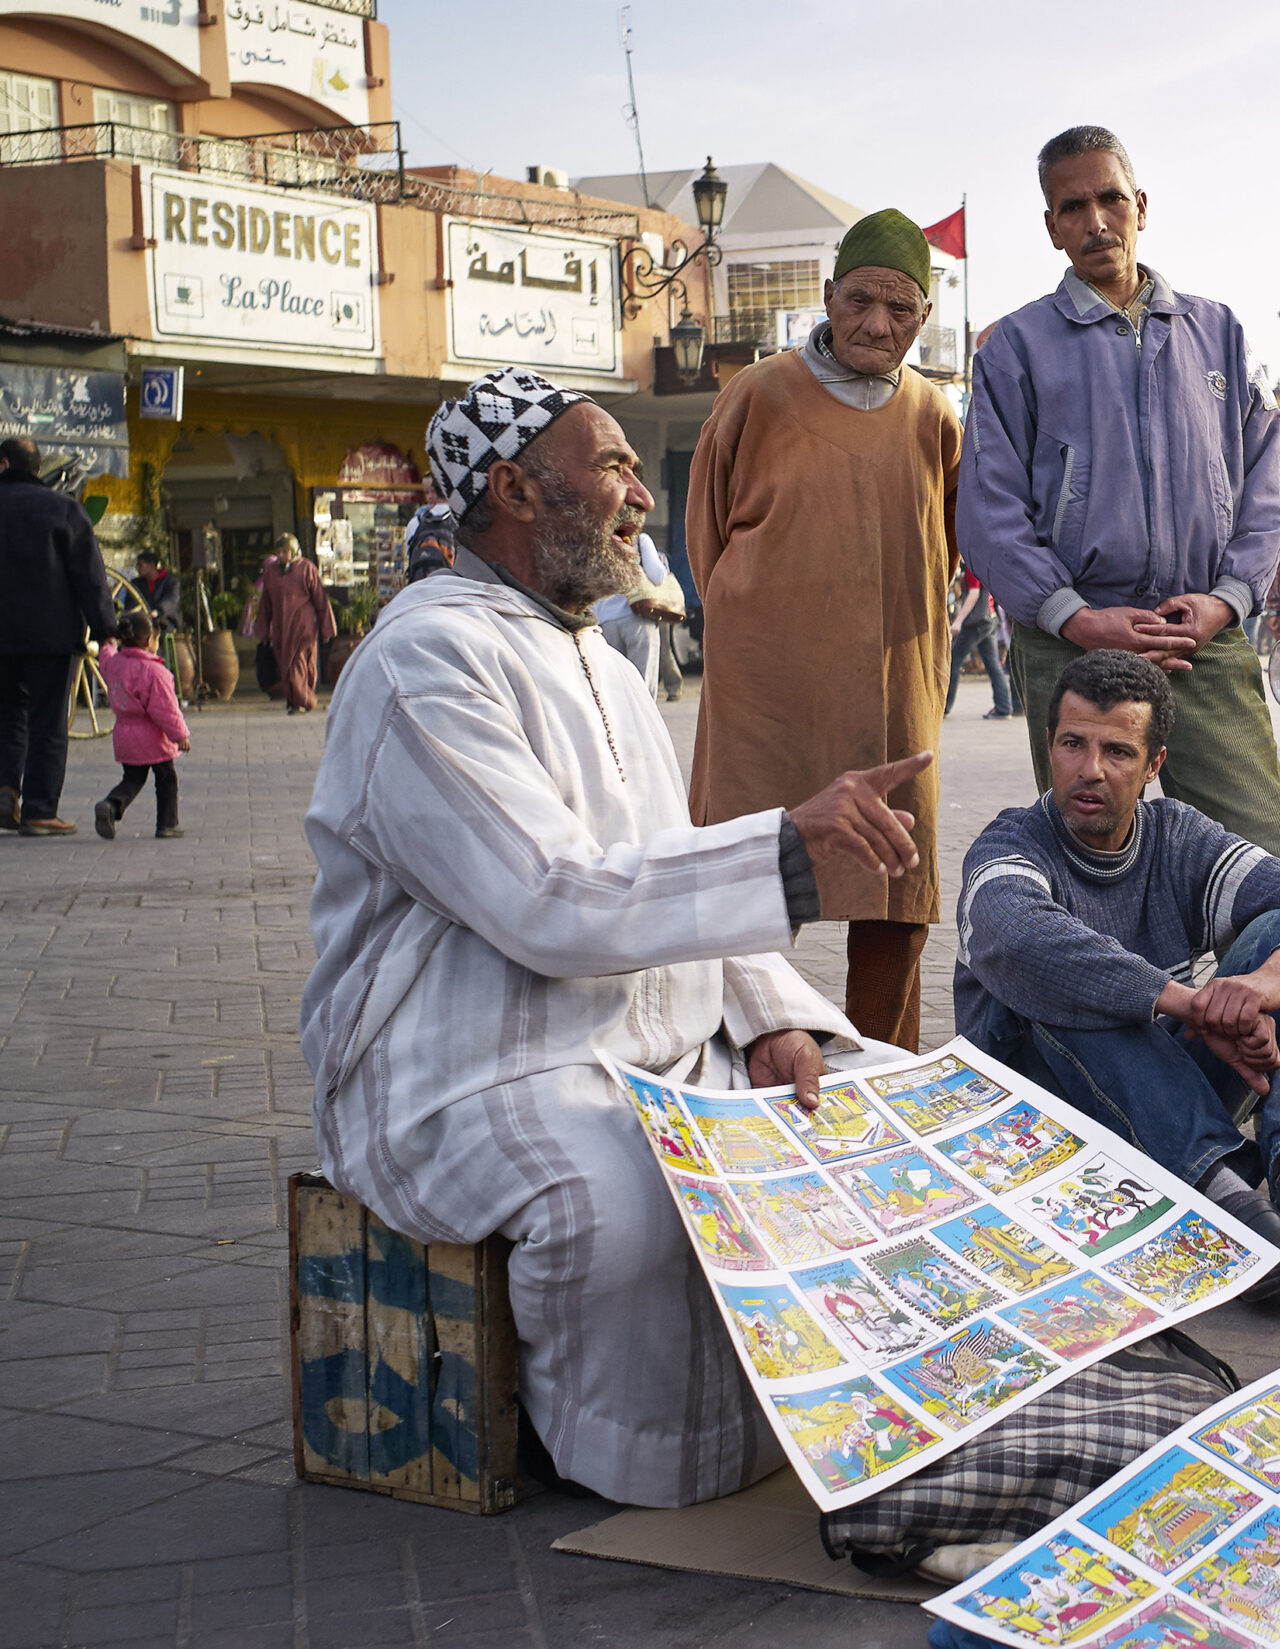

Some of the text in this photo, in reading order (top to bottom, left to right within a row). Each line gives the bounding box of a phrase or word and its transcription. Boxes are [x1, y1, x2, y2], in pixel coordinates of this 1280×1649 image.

[269, 5, 316, 37] شامل
[163, 192, 361, 268] RESIDENCE
[466, 243, 599, 306] إقامة
[479, 307, 557, 346] الساحة
